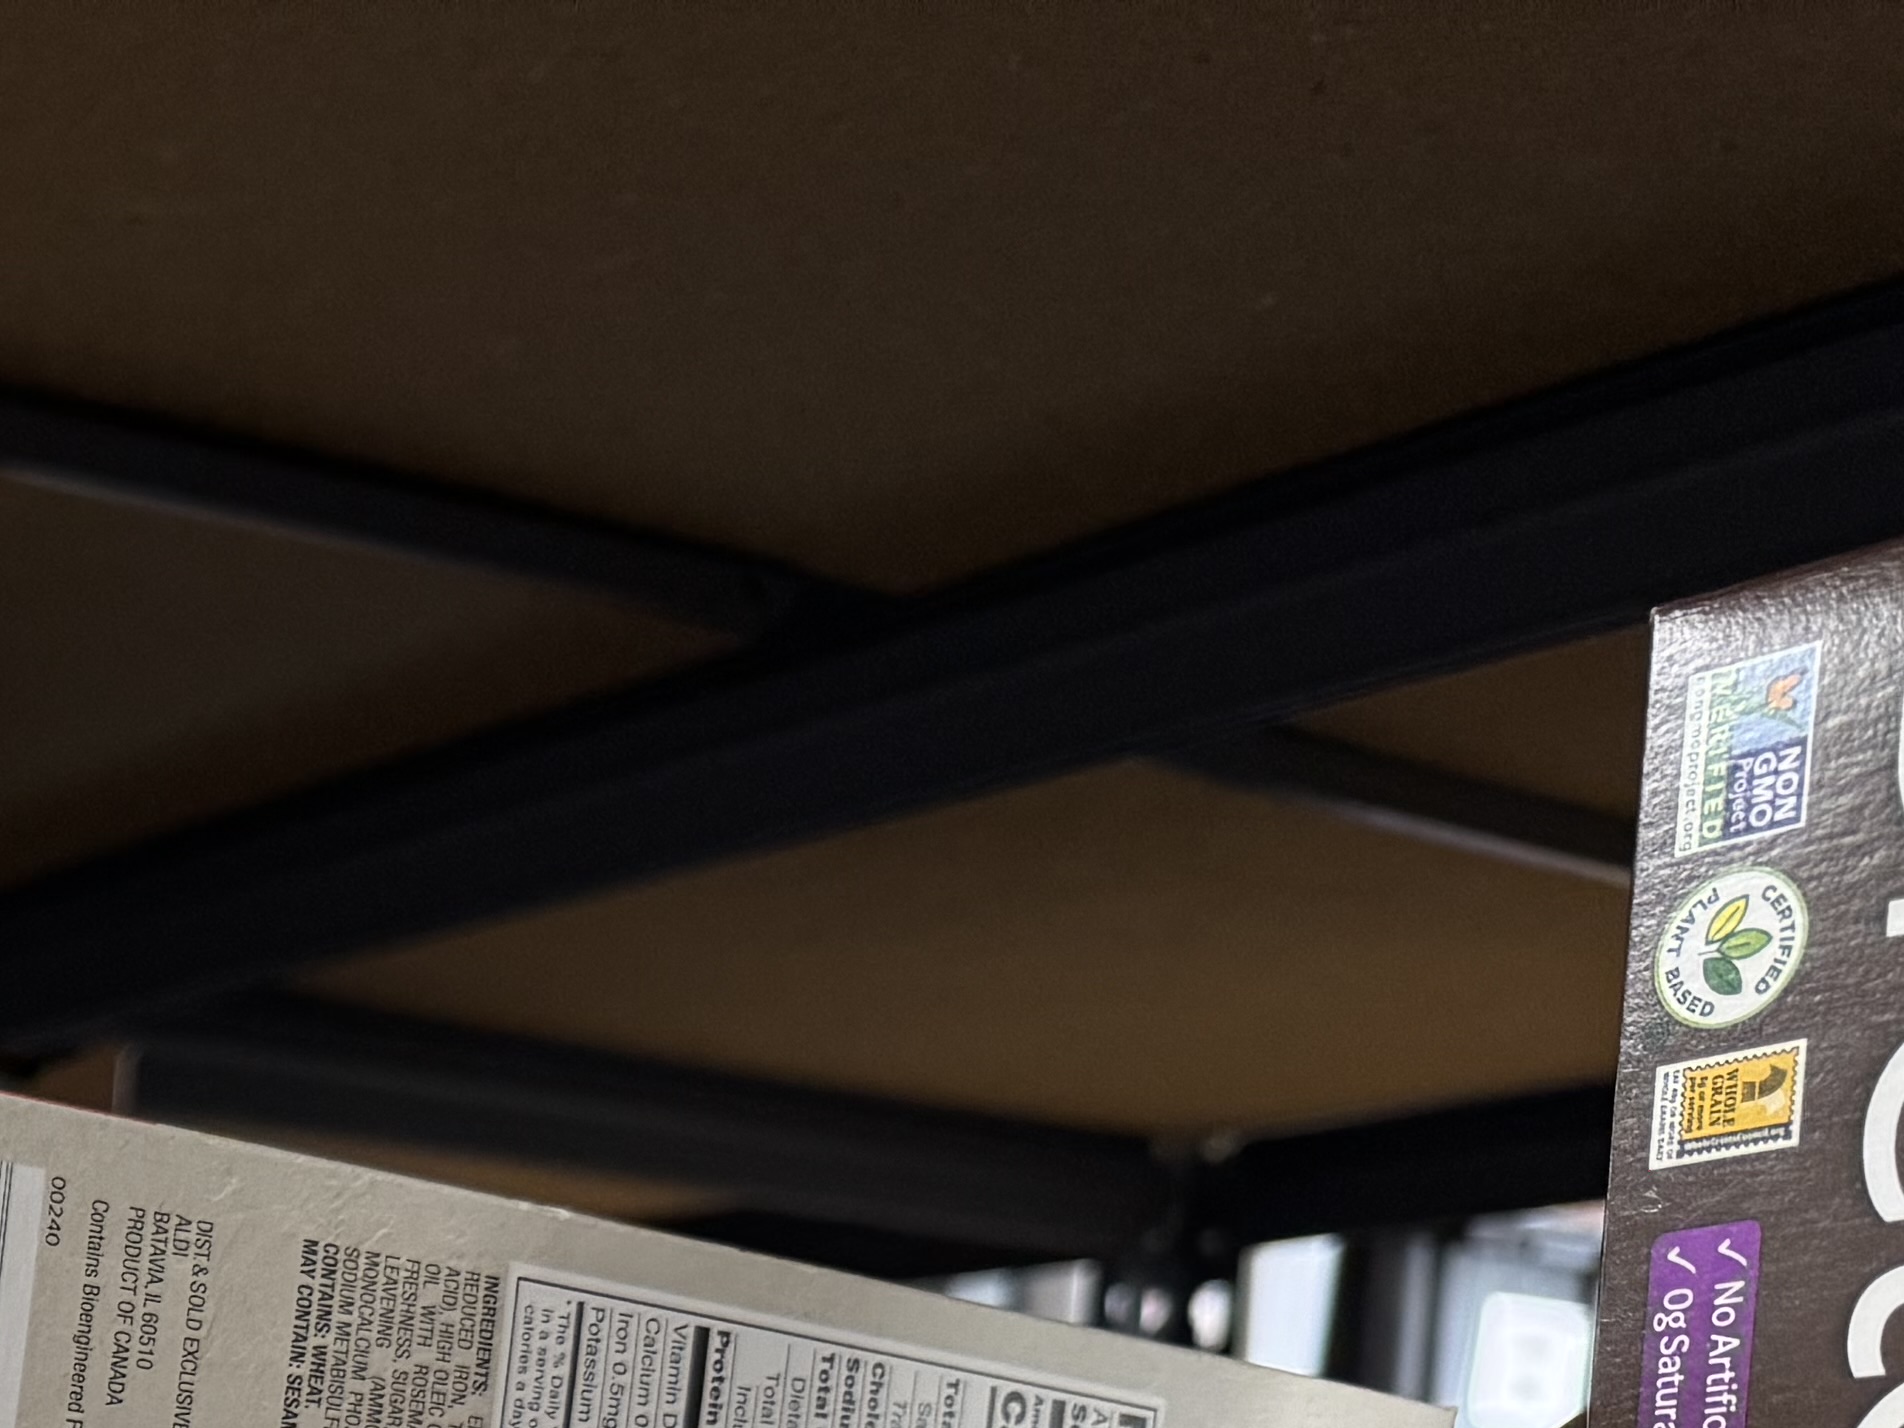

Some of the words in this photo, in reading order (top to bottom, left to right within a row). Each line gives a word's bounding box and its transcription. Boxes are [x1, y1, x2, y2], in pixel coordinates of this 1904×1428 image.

[1701, 668, 1734, 841] VERIFIED
[1748, 751, 1777, 828] GMO
[1772, 745, 1802, 822] NON
[1727, 756, 1755, 833] Project
[1666, 886, 1721, 957] PLANT
[1753, 884, 1796, 996] CERTIFIED
[1664, 966, 1716, 1020] BASED
[1708, 1074, 1724, 1127] GRAIN
[1722, 1068, 1739, 1128] WHOLE
[45, 1175, 67, 1247] 00240
[84, 1199, 111, 1278] Contains
[171, 1213, 193, 1258] ALDI
[192, 1219, 214, 1263] DIST.
[119, 1206, 147, 1297] PRODUCT
[191, 1263, 210, 1278] &
[298, 1237, 320, 1281] MAY
[116, 1300, 137, 1327] OF
[142, 1292, 162, 1308] IL
[185, 1280, 208, 1332] SOLD
[312, 1241, 341, 1339] CONTAINS:
[1652, 1288, 1694, 1332] 0g
[1711, 1280, 1746, 1328] No
[67, 1283, 101, 1414] Bioengineered
[135, 1311, 160, 1371] 60510
[287, 1283, 315, 1369] CONTAIN:
[469, 1273, 501, 1397] INGREDIENTS:
[104, 1330, 132, 1406] CANADA
[303, 1343, 329, 1409] WHEAT.
[663, 1322, 690, 1405] Vitamin
